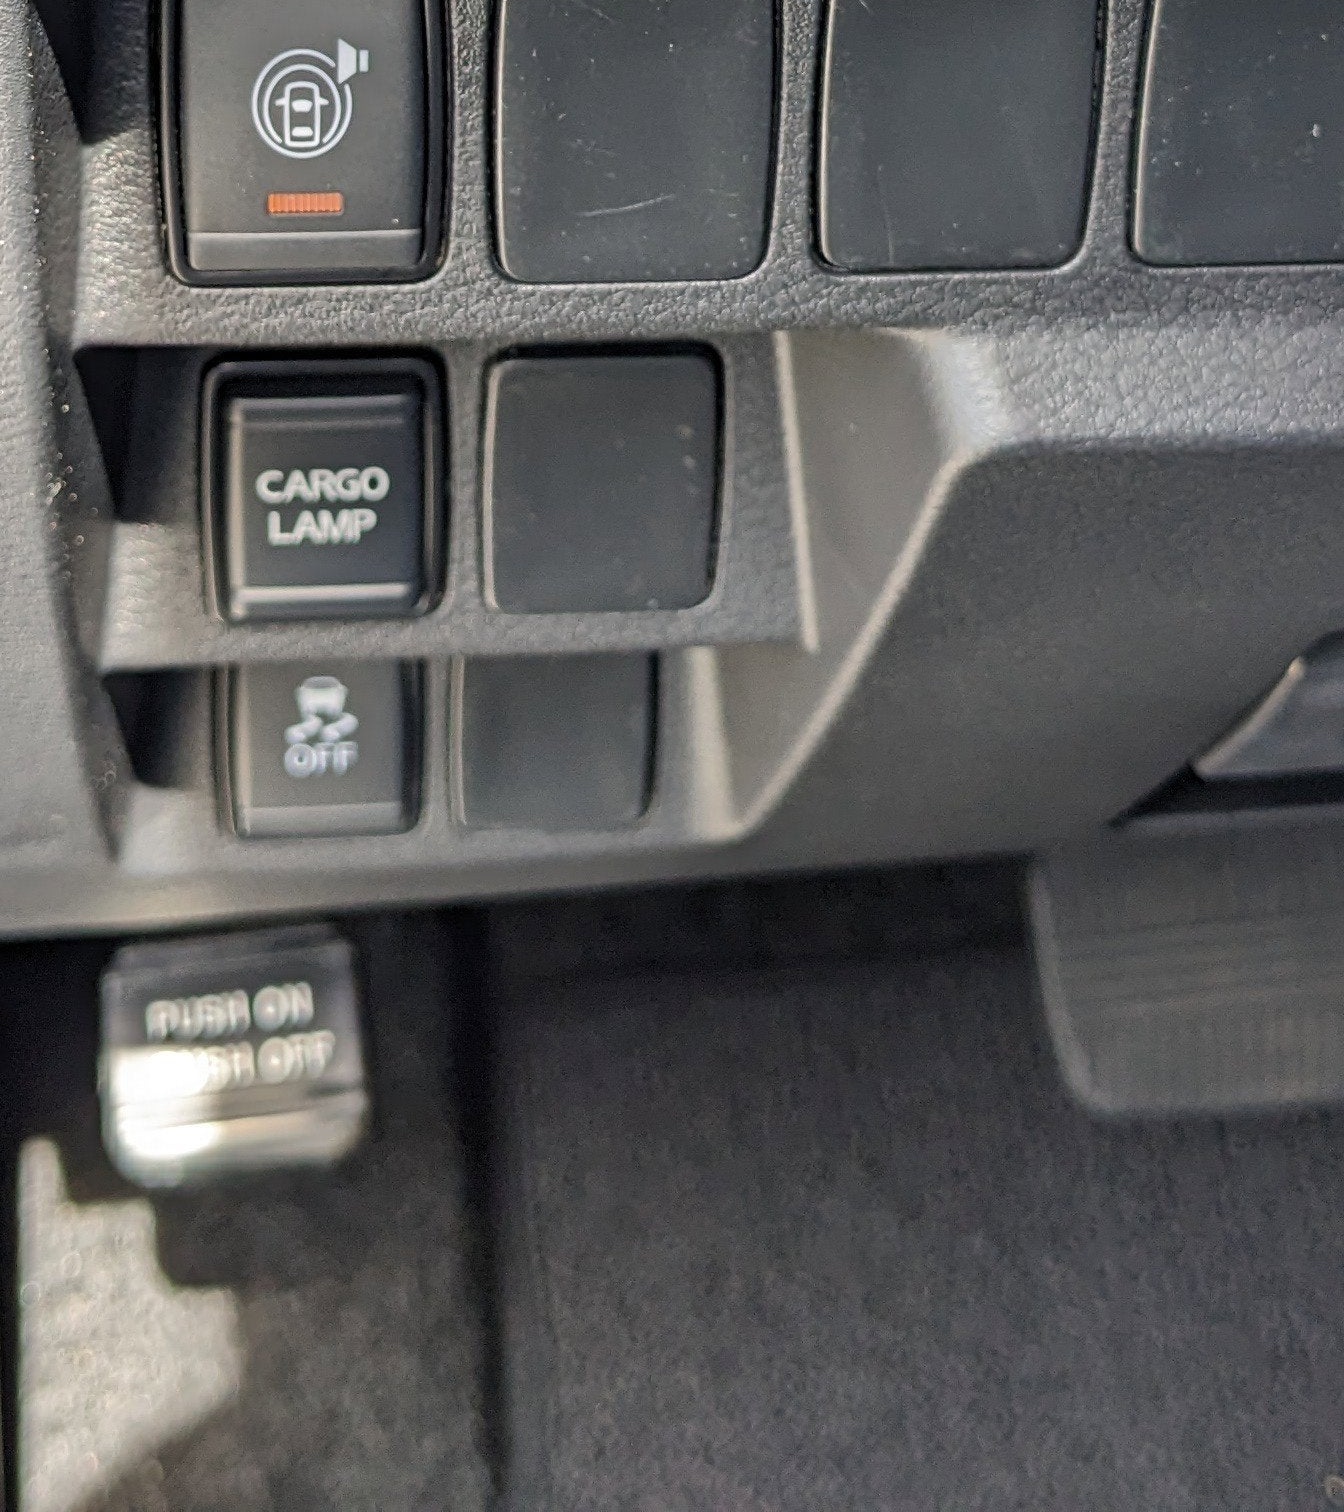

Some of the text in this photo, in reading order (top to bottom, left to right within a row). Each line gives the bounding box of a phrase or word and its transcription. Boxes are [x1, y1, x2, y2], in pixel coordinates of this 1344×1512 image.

[256, 466, 390, 504] CARGO
[267, 508, 378, 546] LAMP
[145, 981, 314, 1039] PUSH ON
[257, 1029, 336, 1085] OFF
